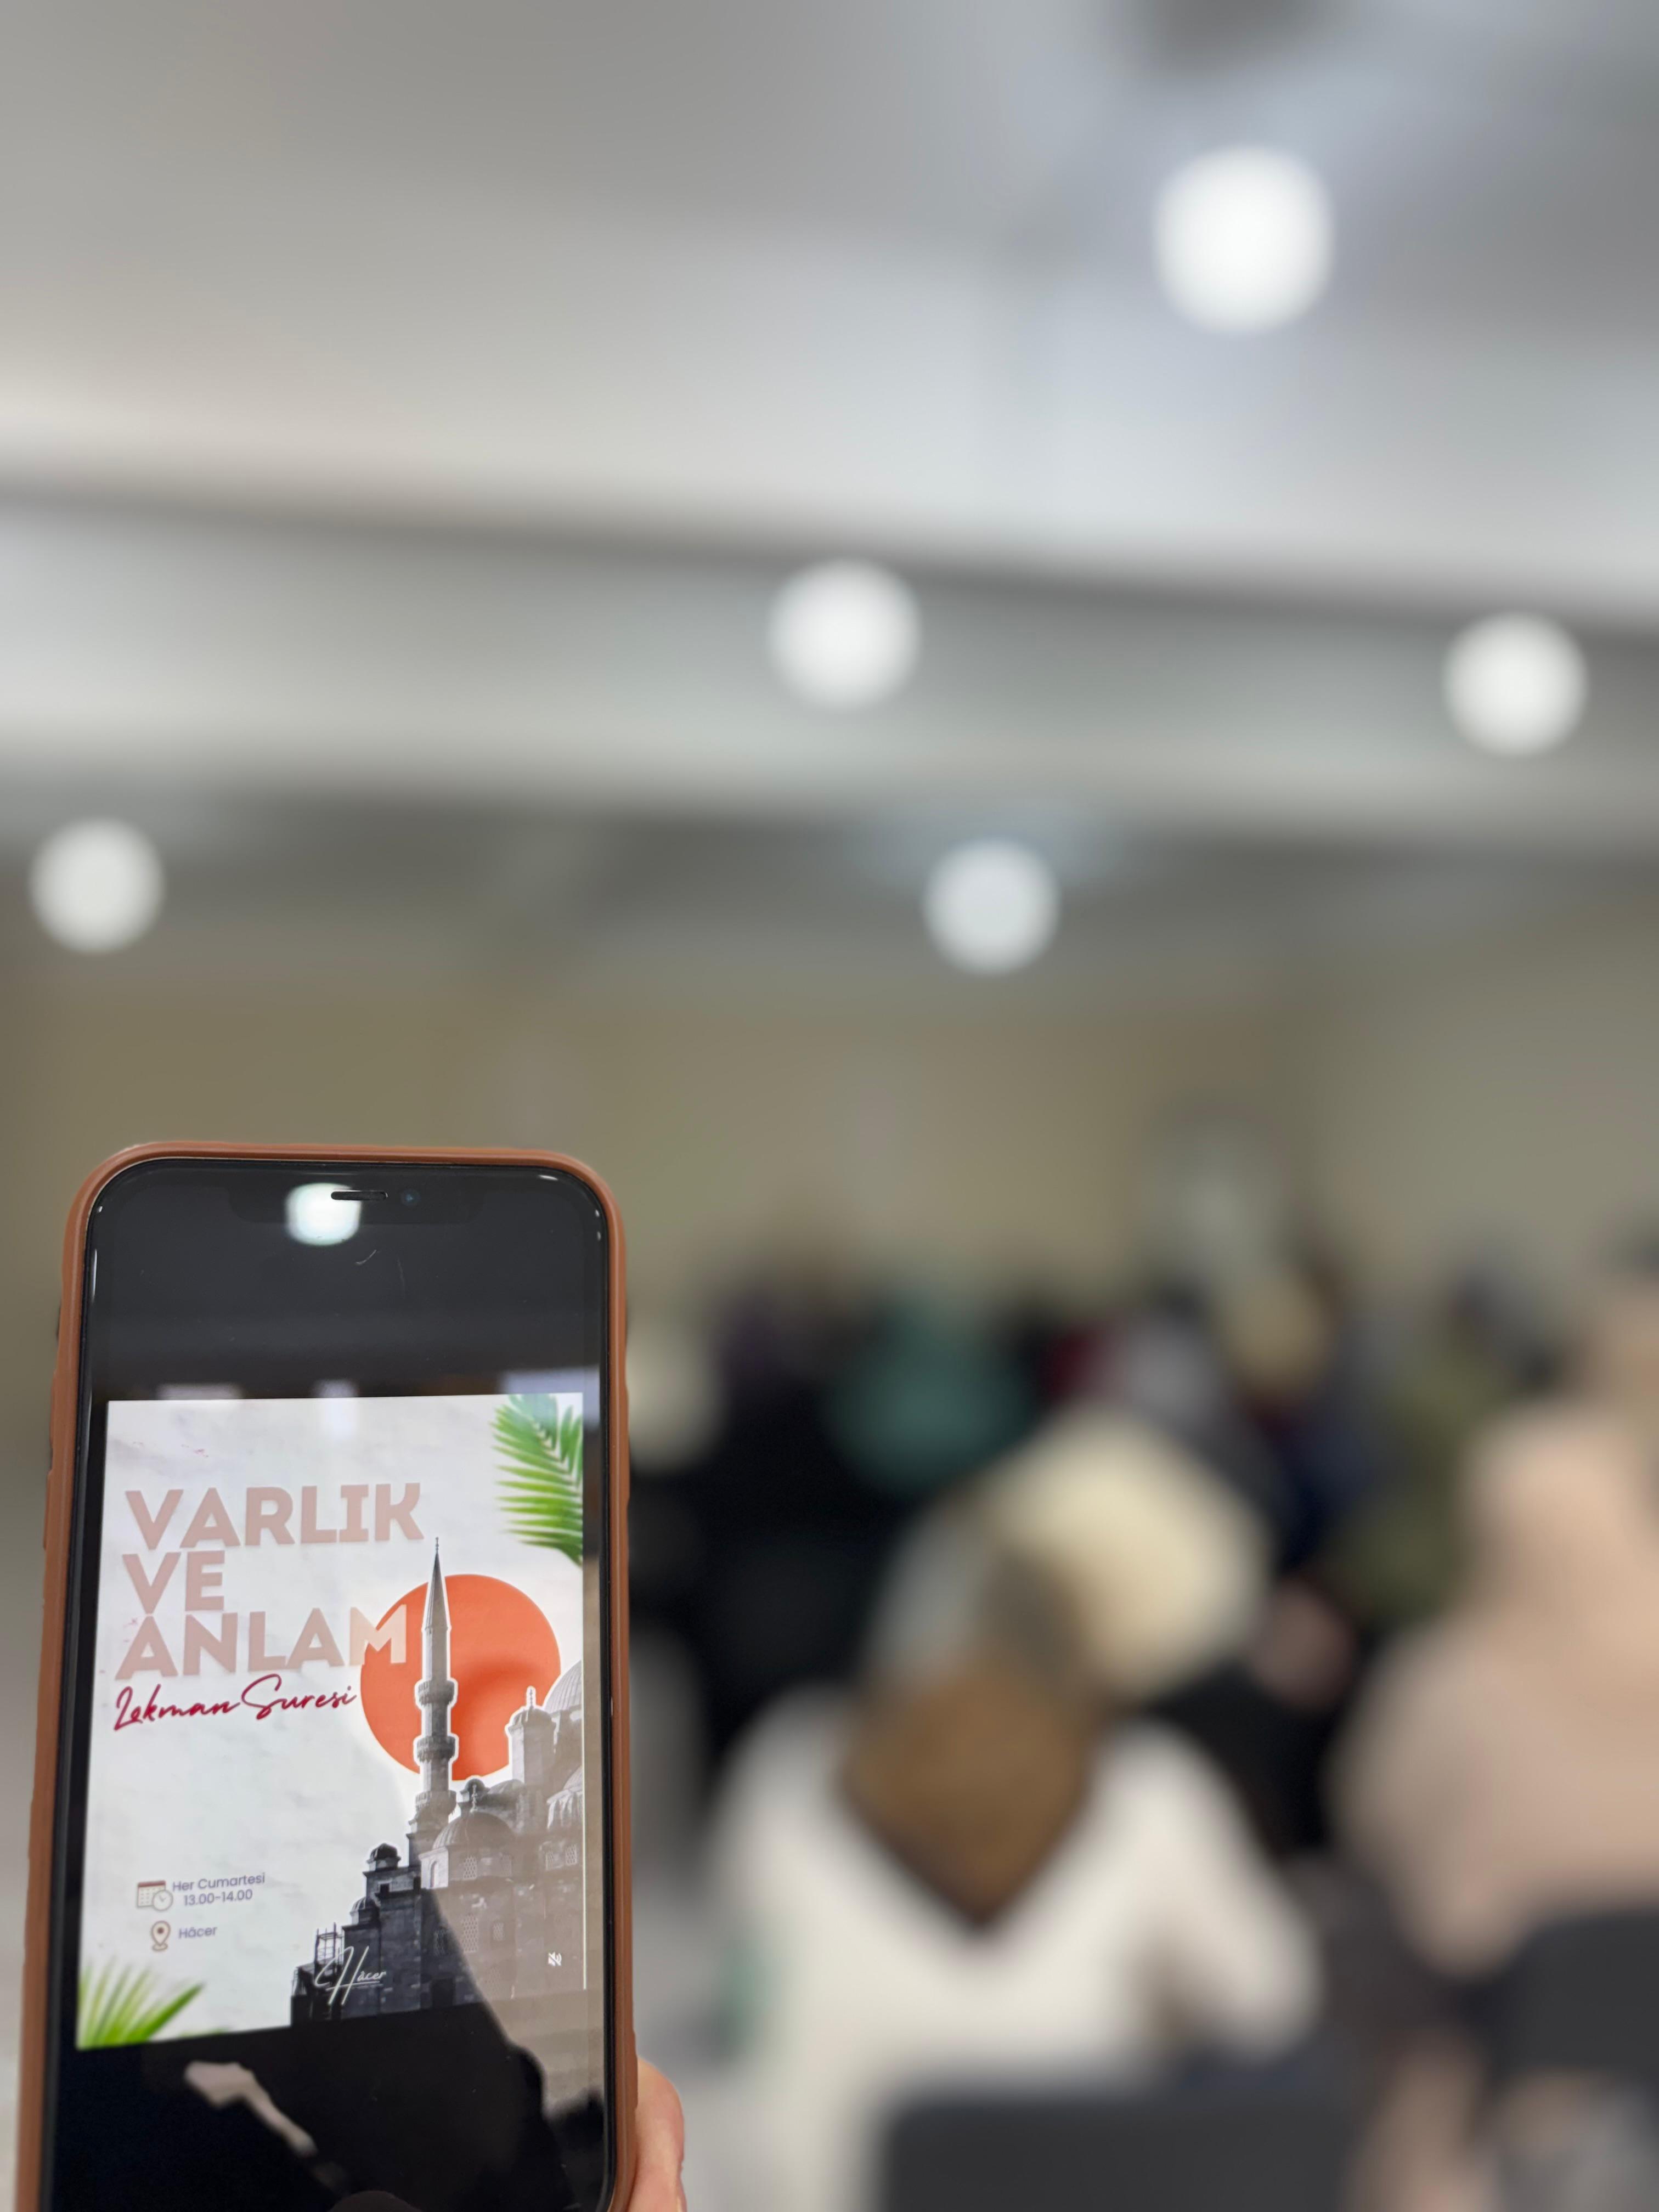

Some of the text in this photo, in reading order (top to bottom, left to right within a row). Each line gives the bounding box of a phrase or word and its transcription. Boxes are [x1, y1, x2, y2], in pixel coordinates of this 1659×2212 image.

[125, 1483, 424, 1550] VARLIK
[122, 1550, 225, 1614] VE
[115, 1604, 407, 1680] ANLAM
[241, 1674, 357, 1720] Suresi
[173, 1872, 265, 1892] Her Cumartesi
[184, 1889, 252, 1906] 13.00-14.00
